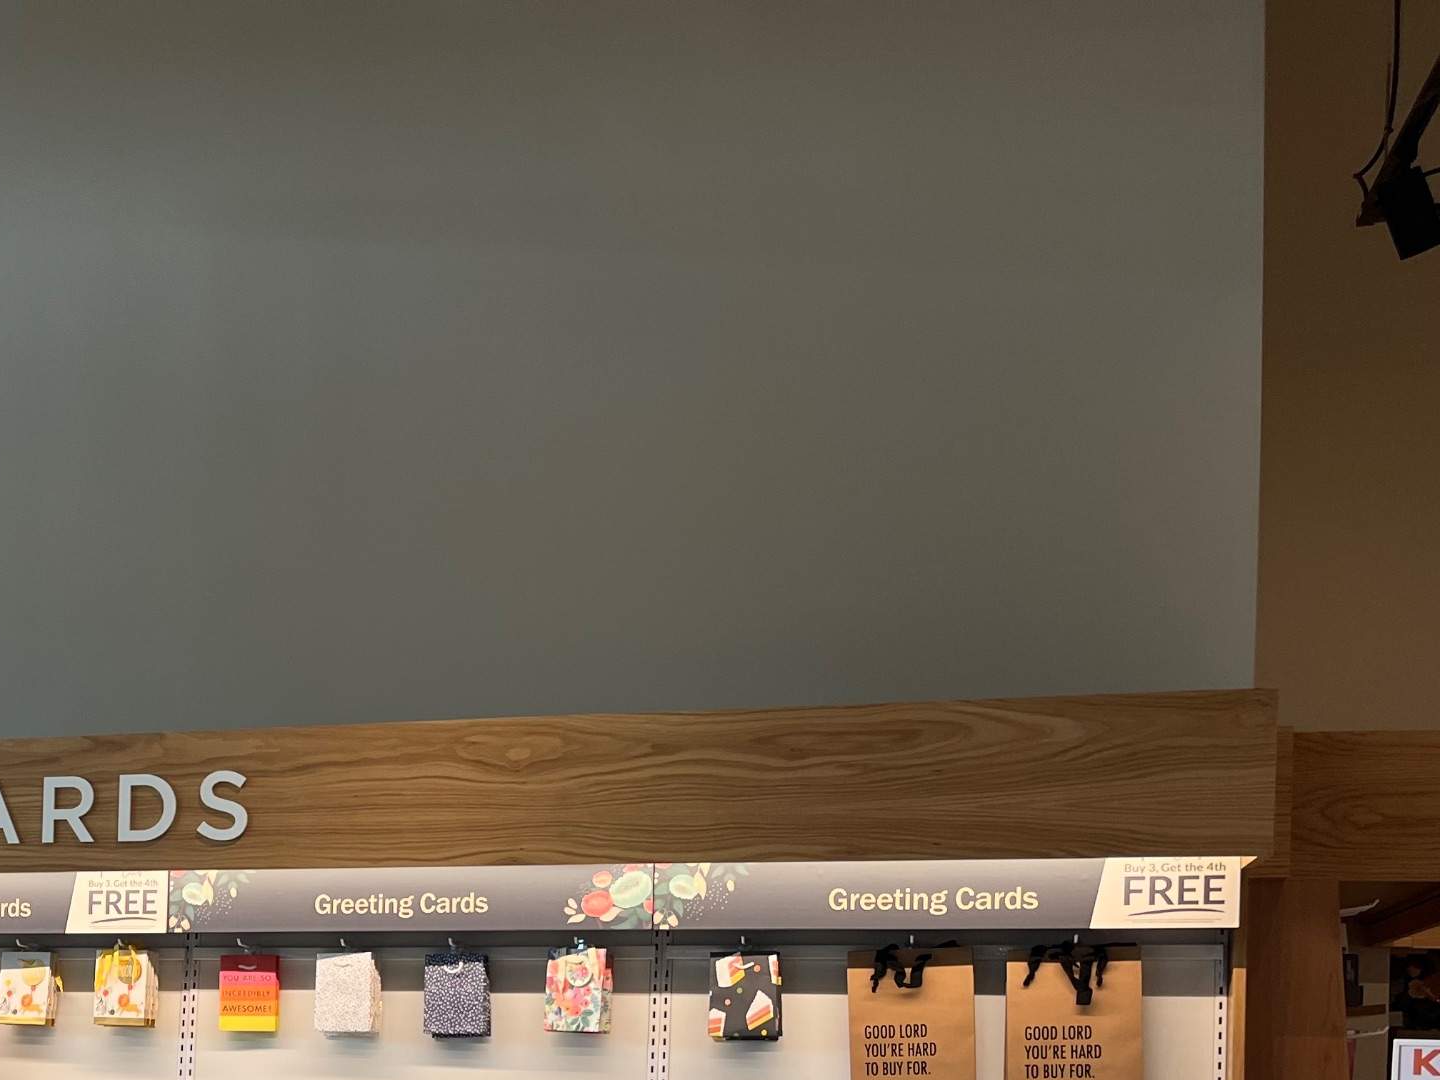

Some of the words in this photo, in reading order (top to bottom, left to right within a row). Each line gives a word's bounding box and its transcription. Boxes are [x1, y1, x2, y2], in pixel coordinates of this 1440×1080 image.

[1123, 864, 1146, 875] Buy
[1160, 863, 1182, 873] Get
[1184, 862, 1203, 873] the
[1205, 861, 1226, 872] 4th
[1123, 875, 1226, 906] FREE
[87, 890, 157, 915] FREE
[314, 893, 414, 918] Greeting
[420, 891, 488, 915] Cards
[828, 888, 948, 915] Greeting
[955, 886, 1039, 910] Cards
[222, 1005, 272, 1013] AWESOME!
[864, 1024, 896, 1039] GOOD
[898, 1023, 928, 1038] LORD
[1024, 1026, 1058, 1041] GOOD
[1061, 1025, 1092, 1040] LORD
[864, 1043, 904, 1058] YOU'RE
[907, 1042, 937, 1057] HARD
[1024, 1044, 1067, 1059] YOU'RE
[1070, 1044, 1102, 1060] HARD
[865, 1062, 879, 1076] TO
[881, 1061, 903, 1076] BUY
[906, 1061, 931, 1076] FOR.
[1025, 1064, 1040, 1079] TO
[1042, 1063, 1066, 1079] BUY
[1068, 1063, 1095, 1079] FOR.
